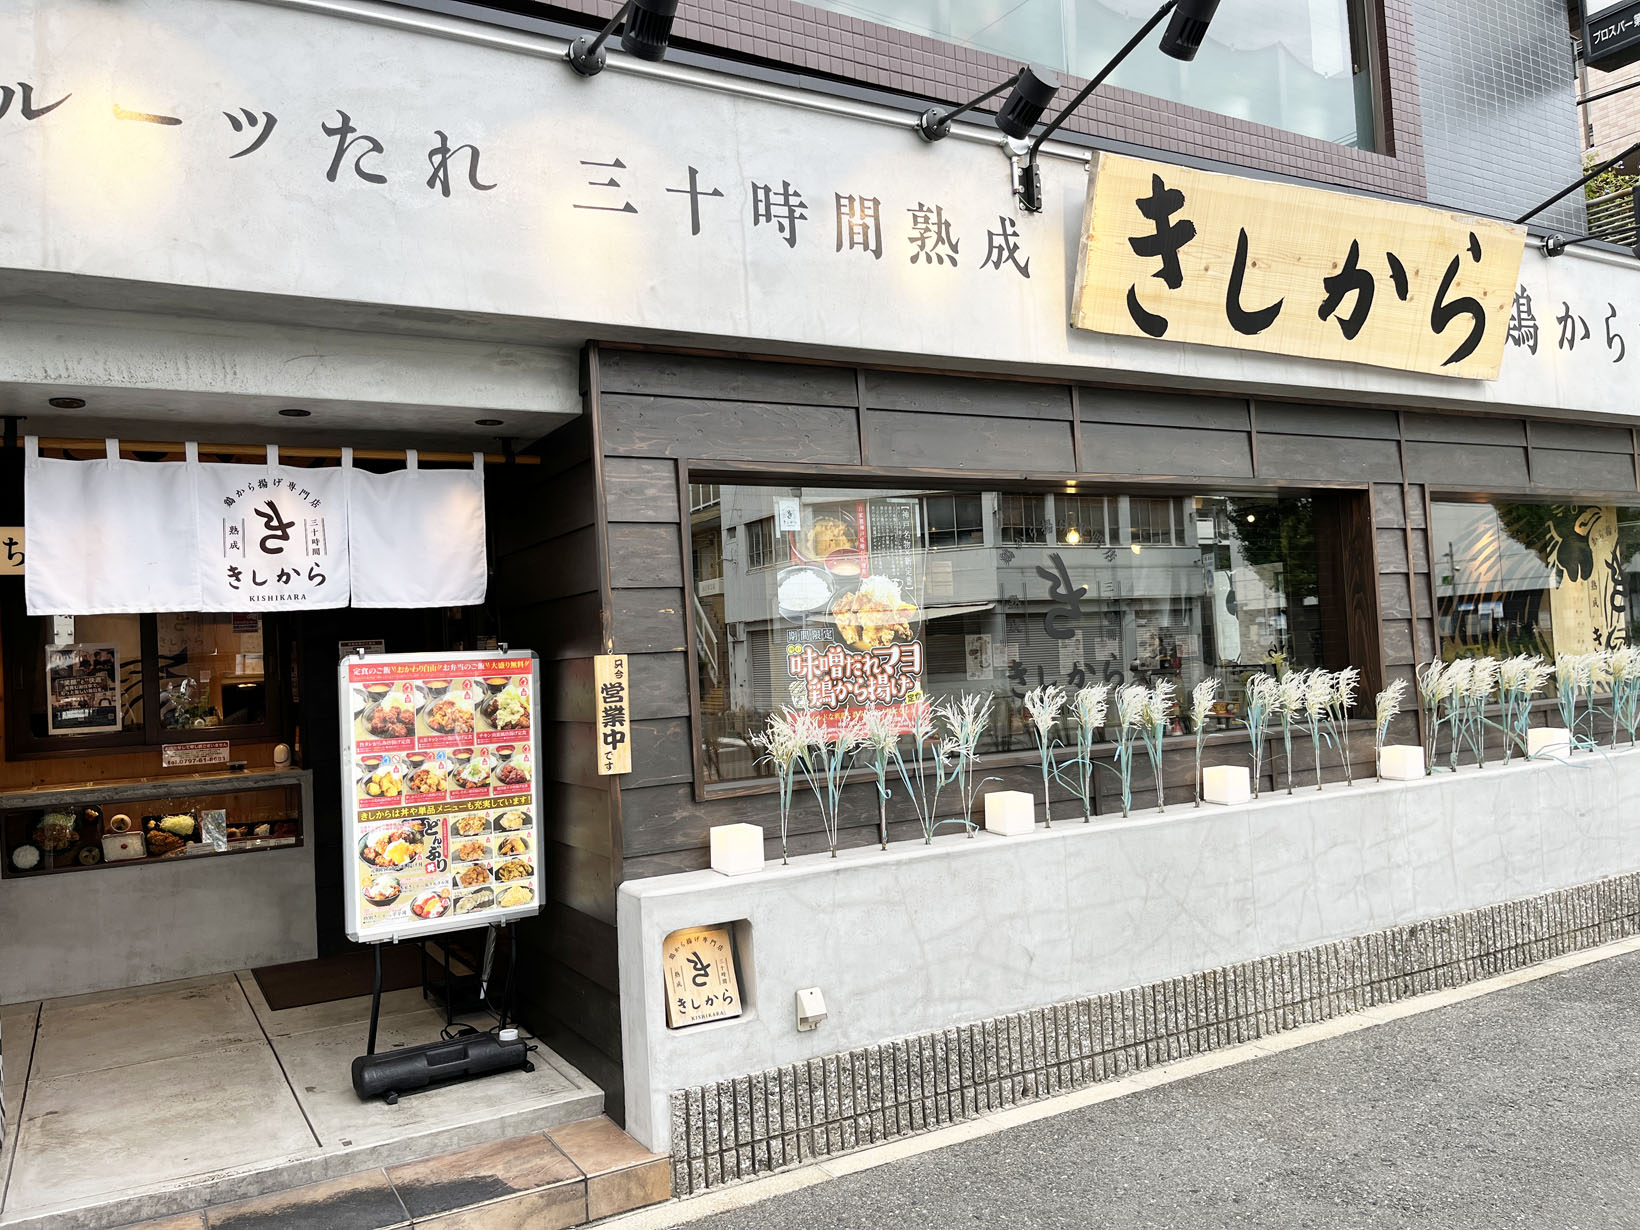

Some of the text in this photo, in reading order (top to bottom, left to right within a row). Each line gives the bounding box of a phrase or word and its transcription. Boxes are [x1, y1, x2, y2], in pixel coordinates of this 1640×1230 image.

[573, 156, 1032, 279] 三十時間熟成
[1126, 172, 1487, 367] きしから
[223, 478, 322, 508] 鶏から揚げ専門店
[2, 536, 25, 567] ち
[228, 525, 240, 551] 熟成
[308, 519, 321, 556] 三十時間
[227, 561, 327, 590] きしから
[249, 593, 307, 602] KISHIKARA
[789, 641, 922, 680] 味噌だれマヨ
[806, 674, 915, 709] 鶏から揚げ
[600, 658, 626, 771] 只今 営業中 です
[424, 818, 448, 873] どんぶり
[677, 988, 734, 1015] きしから
[691, 1010, 724, 1021] KISHIKARA
